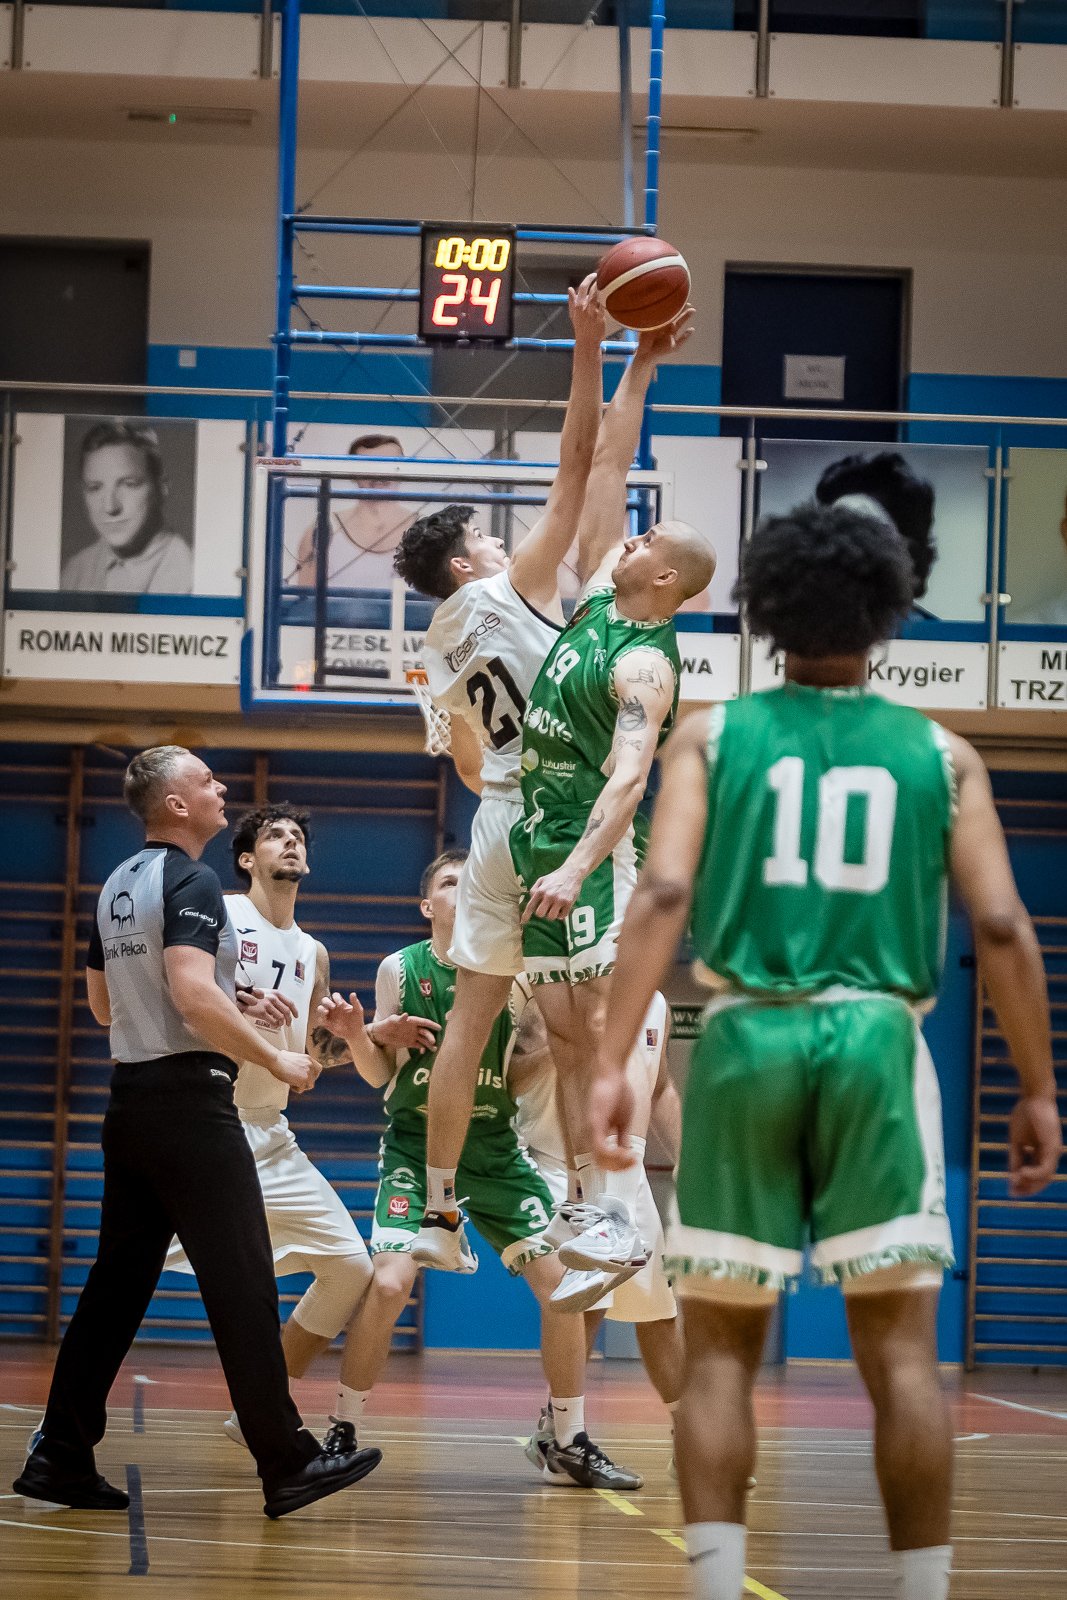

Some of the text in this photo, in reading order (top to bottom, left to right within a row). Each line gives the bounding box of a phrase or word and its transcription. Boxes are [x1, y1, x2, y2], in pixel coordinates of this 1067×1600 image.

[434, 236, 511, 272] 10:00
[432, 273, 502, 327] 24
[20, 628, 229, 657] ROMAN MISIEWICZ
[546, 642, 581, 685] 19
[867, 659, 966, 688] Krygier
[466, 655, 527, 750] 21
[763, 756, 898, 895] 10
[103, 940, 148, 961] ank Pekao
[271, 959, 286, 990] 7
[519, 1195, 549, 1229] 3
